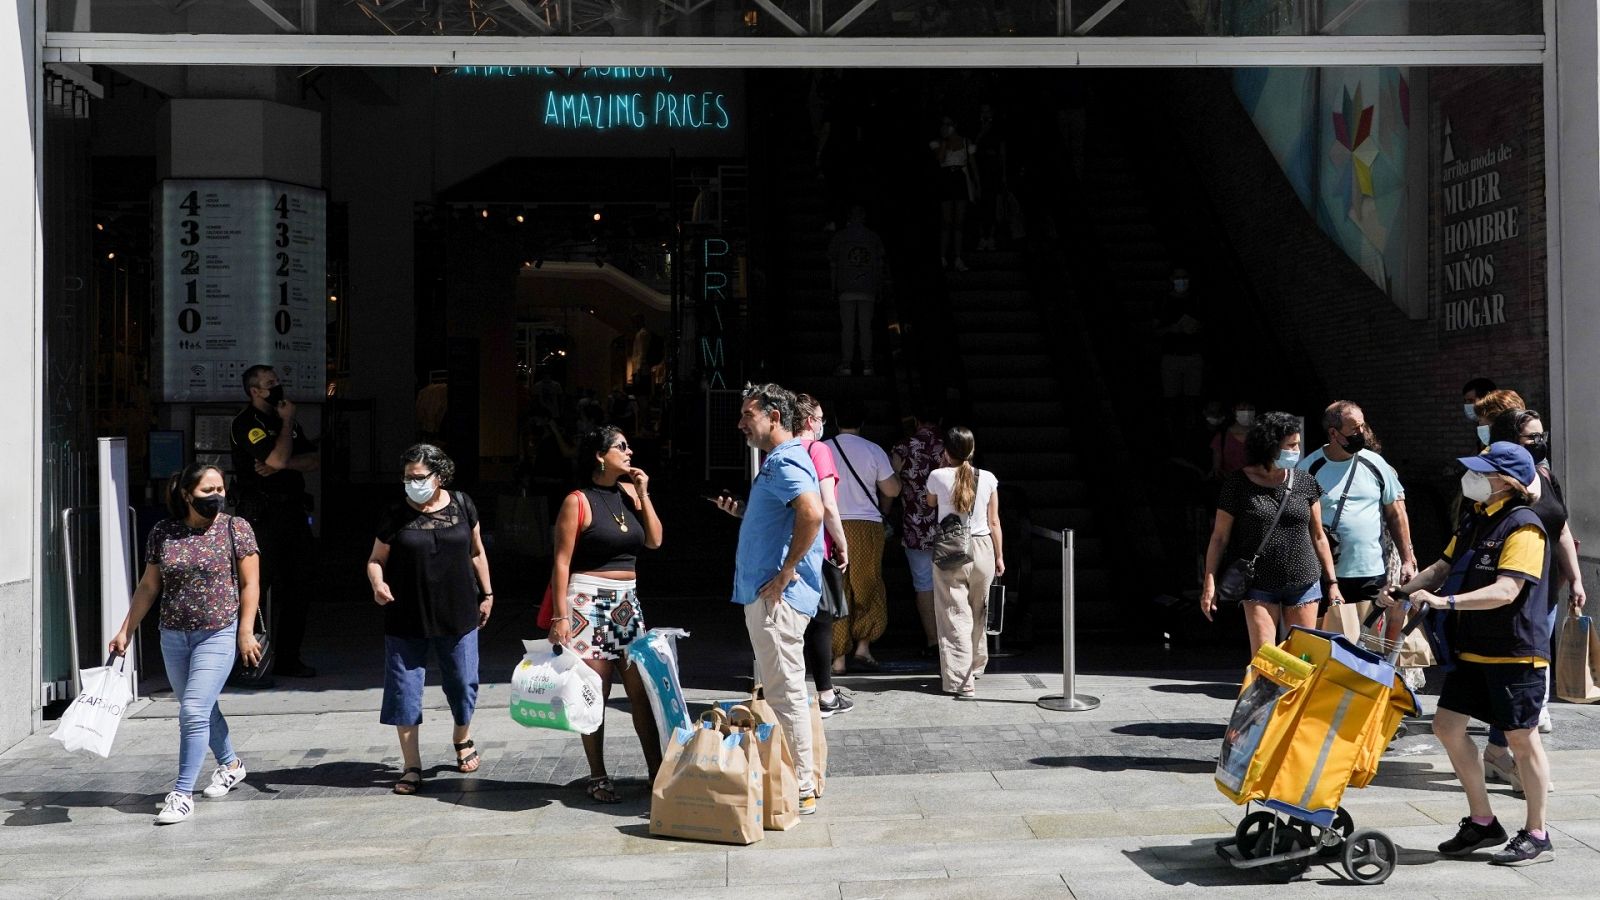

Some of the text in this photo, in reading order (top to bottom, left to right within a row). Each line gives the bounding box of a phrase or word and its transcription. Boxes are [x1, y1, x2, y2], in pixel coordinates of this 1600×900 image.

[544, 90, 729, 129] AMAZING PRICES
[1443, 144, 1512, 182] arriba moda de:
[179, 190, 201, 217] 4
[274, 193, 290, 219] 4
[1444, 171, 1501, 216] MUJER
[180, 220, 200, 246] 3
[275, 222, 289, 248] 3
[1444, 207, 1519, 255] HOMBRE
[180, 250, 200, 275] 2
[276, 252, 290, 277] 2
[1445, 252, 1495, 294] NIÑOS
[185, 279, 199, 304] 1
[278, 281, 289, 306] 1
[178, 308, 202, 334] 0
[1445, 293, 1506, 332] HOGAR
[1475, 563, 1495, 571] Correos
